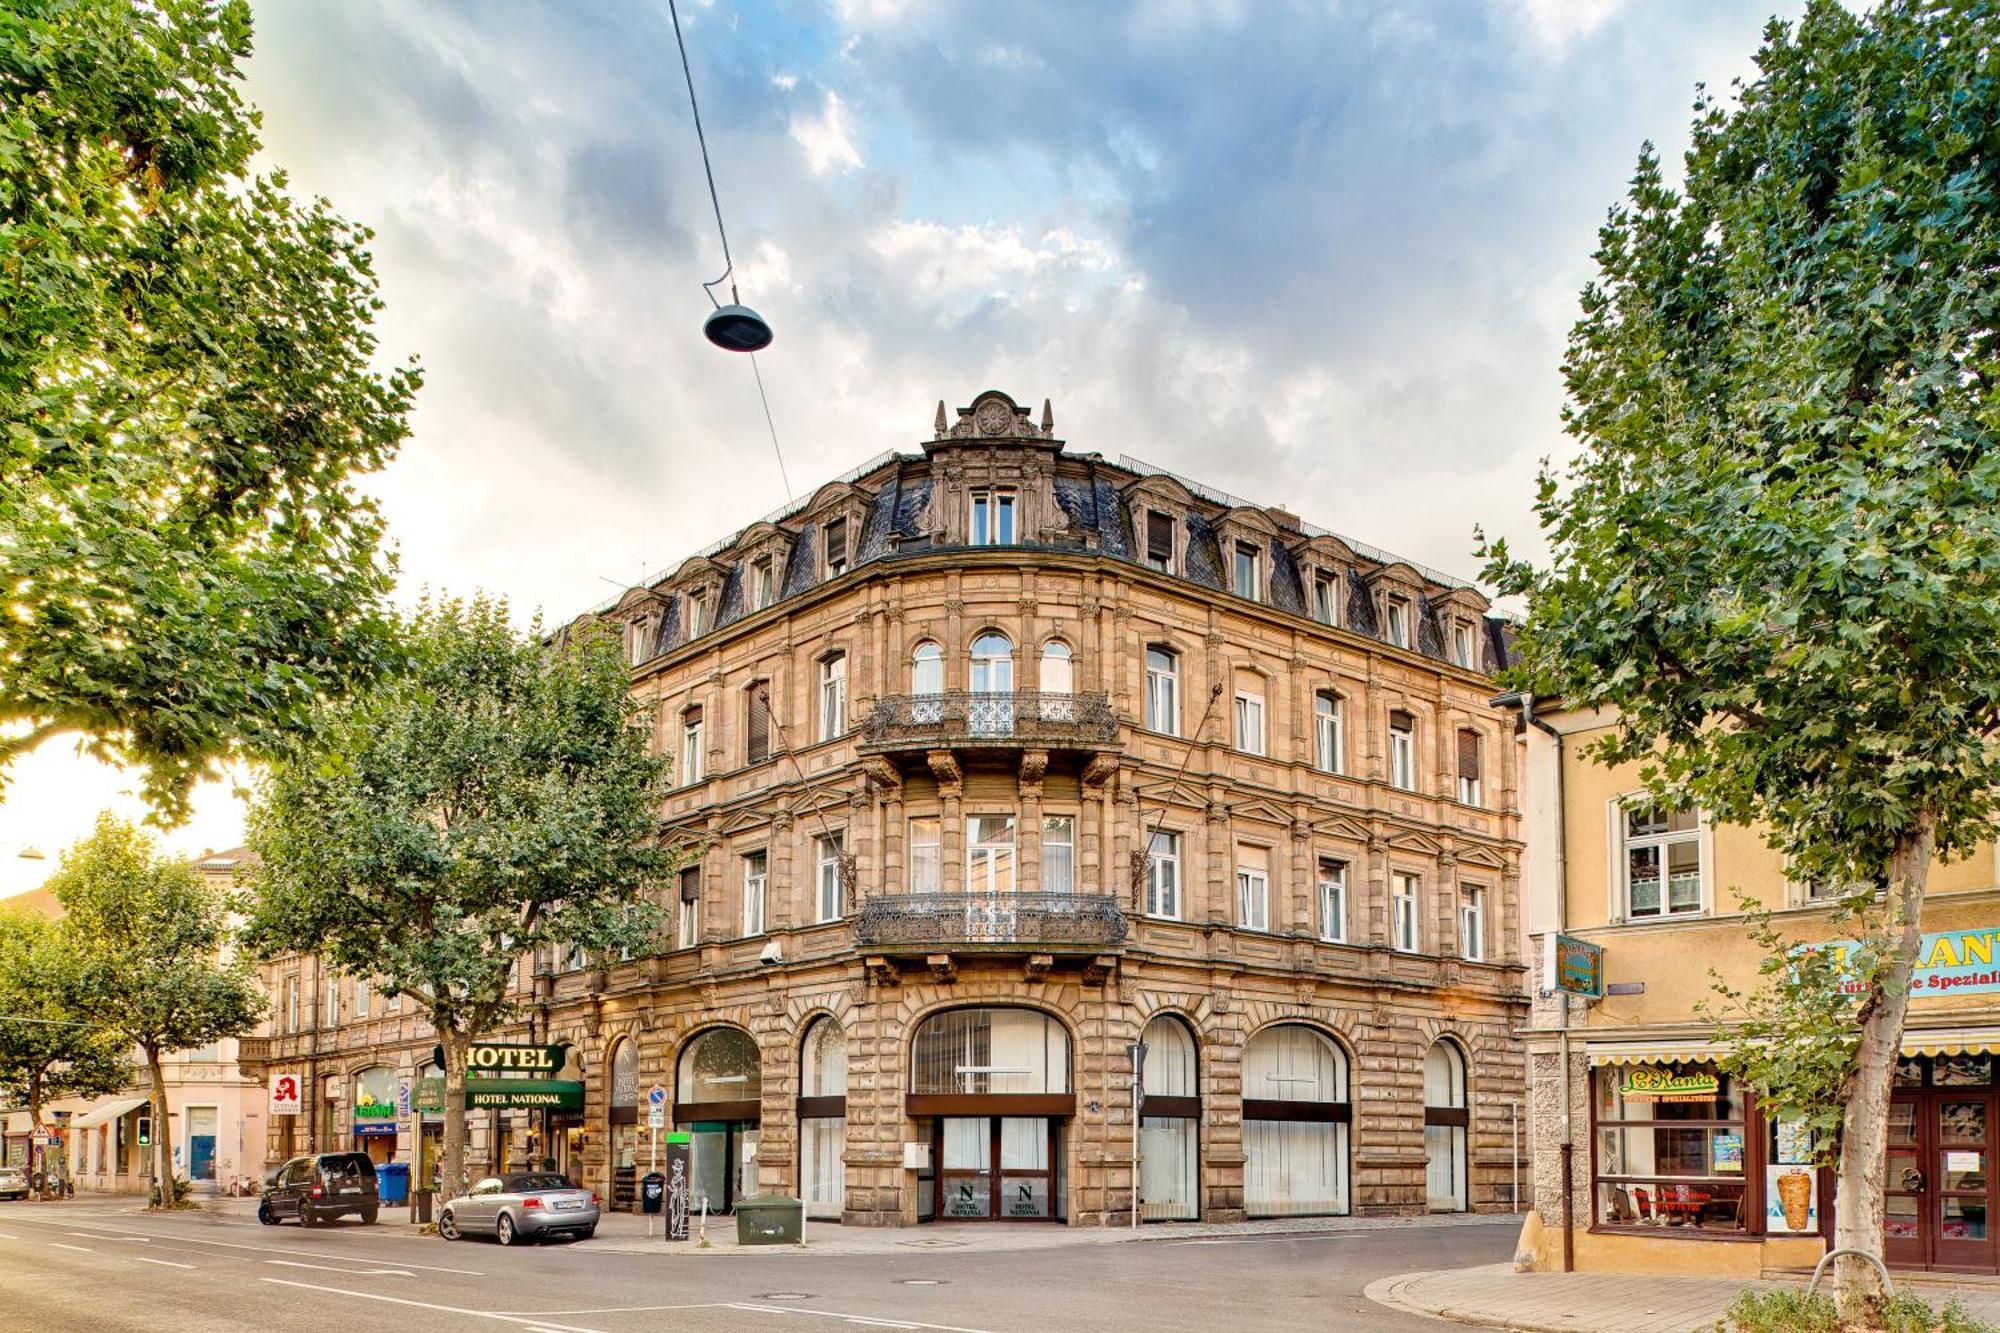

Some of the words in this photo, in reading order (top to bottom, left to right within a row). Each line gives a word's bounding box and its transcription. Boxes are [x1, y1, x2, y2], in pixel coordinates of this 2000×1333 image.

[1928, 970, 2000, 990] Spezial
[474, 1094, 508, 1104] HOTEL
[511, 1094, 560, 1104] NATIONAL
[960, 1186, 973, 1201] N
[1018, 1186, 1032, 1201] N
